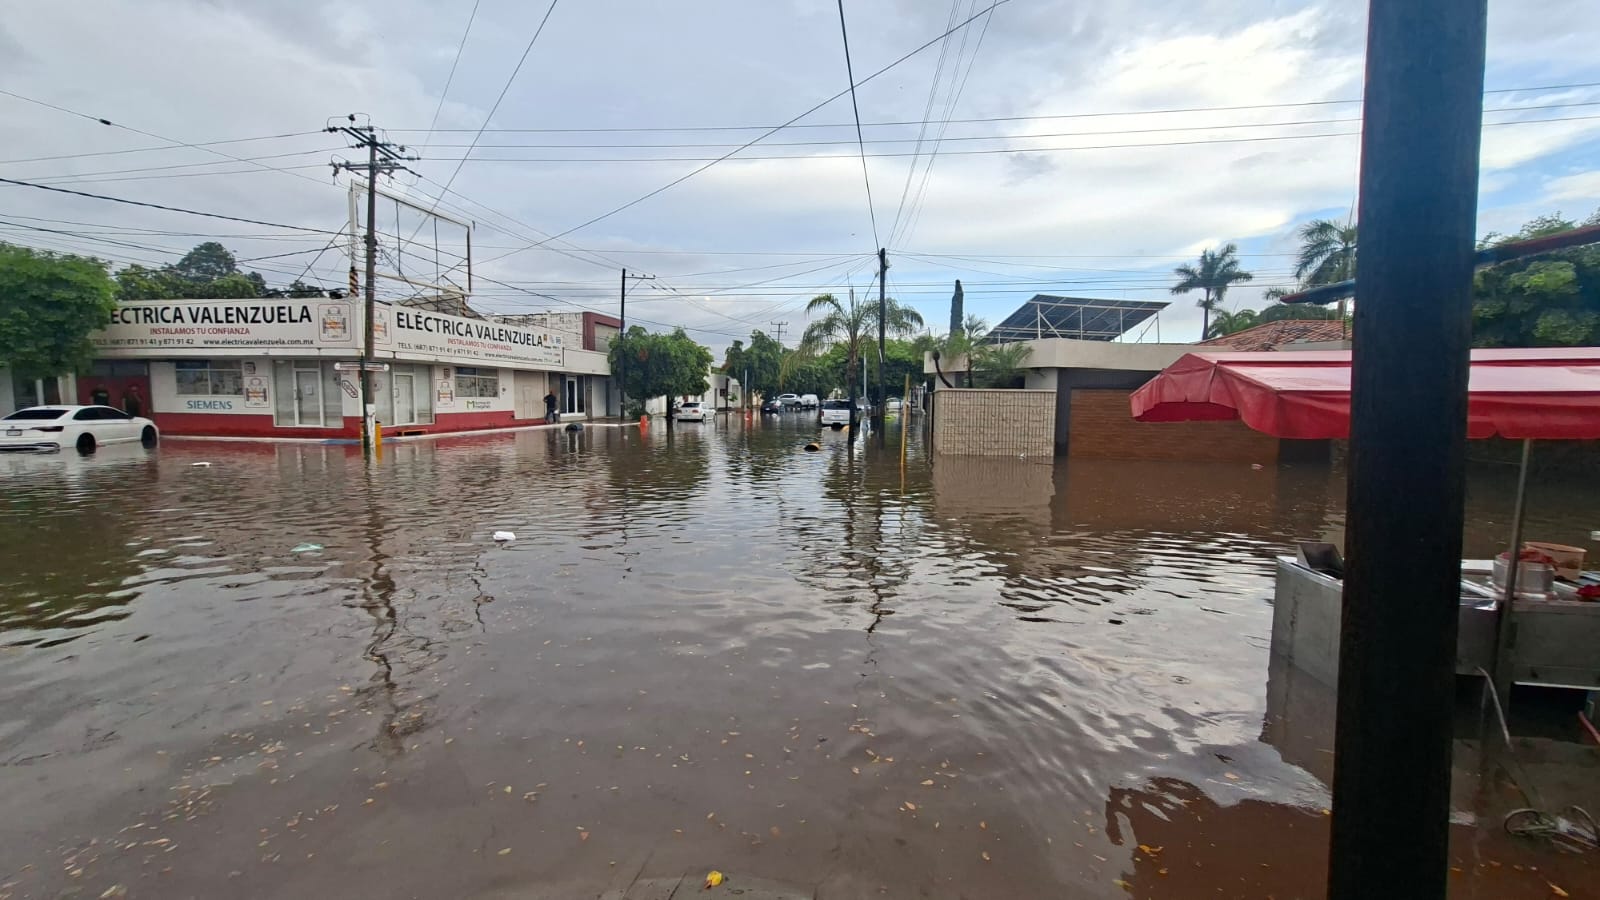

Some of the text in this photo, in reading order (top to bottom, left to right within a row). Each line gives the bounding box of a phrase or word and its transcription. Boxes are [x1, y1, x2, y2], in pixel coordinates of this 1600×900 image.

[111, 305, 312, 324] ECTRICA VALENZUELA
[150, 328, 250, 336] INSTALAMOS TU CONFIANZA
[397, 312, 543, 348] ELÉCTRICA VALENZUELA
[447, 338, 480, 348] INSTALAMOS
[487, 343, 512, 351] CONFIANZA
[186, 400, 233, 410] SIEMENS
